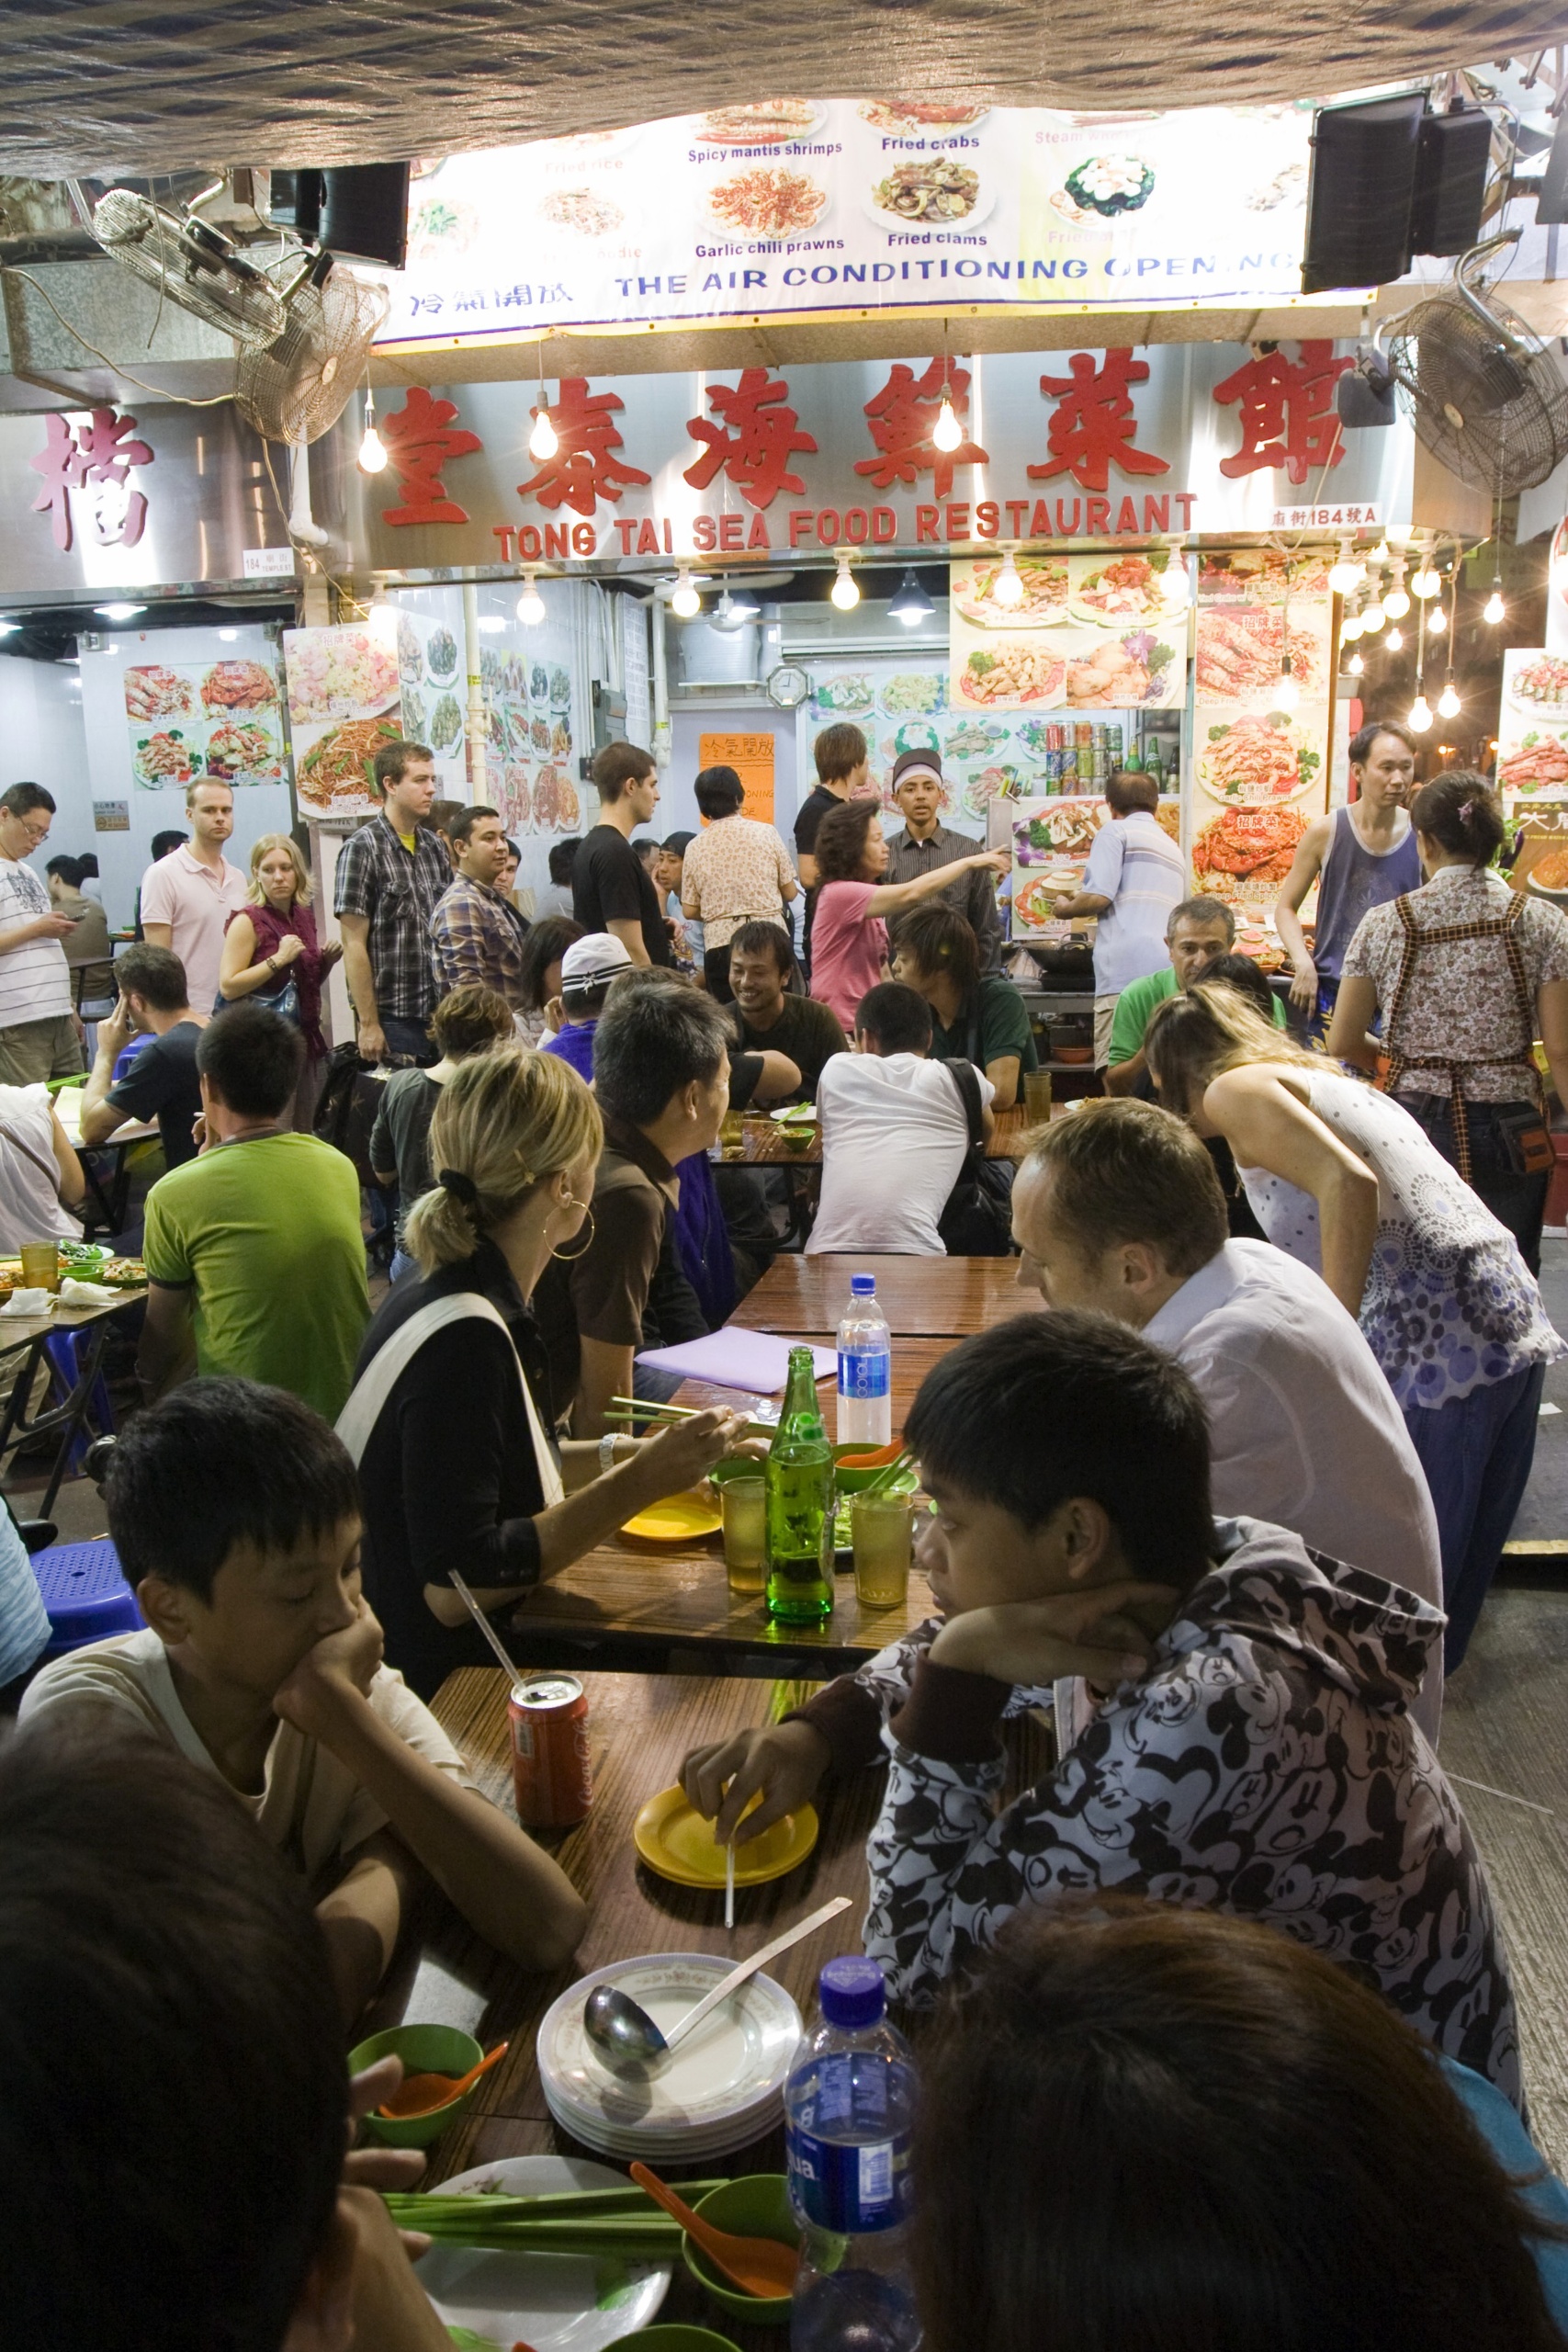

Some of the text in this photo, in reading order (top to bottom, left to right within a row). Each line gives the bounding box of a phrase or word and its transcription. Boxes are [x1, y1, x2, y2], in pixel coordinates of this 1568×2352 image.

[881, 135, 980, 151] Fried crabs
[1034, 130, 1084, 144] Steam
[688, 141, 844, 165] Spicy mantis shrimps
[545, 157, 624, 174] Fried rice
[887, 231, 987, 247] Fried clams
[695, 237, 845, 258] Garlic chili prawns
[615, 276, 686, 298] THE
[703, 270, 768, 294] AIR
[783, 257, 1089, 288] CONDITIONING
[410, 282, 574, 317] 冷氣開放
[493, 492, 1200, 562] TONG TAI SEA FOOD RESTAURANT
[246, 558, 260, 571] 184
[262, 564, 284, 572] TEMPLE
[1244, 616, 1284, 628] 招牌菜
[1199, 697, 1219, 706] Deep
[705, 737, 774, 758] 冷氣開放
[1244, 793, 1261, 801] Chili
[1238, 816, 1278, 828] 招牌菜
[1254, 891, 1276, 899] Spicy
